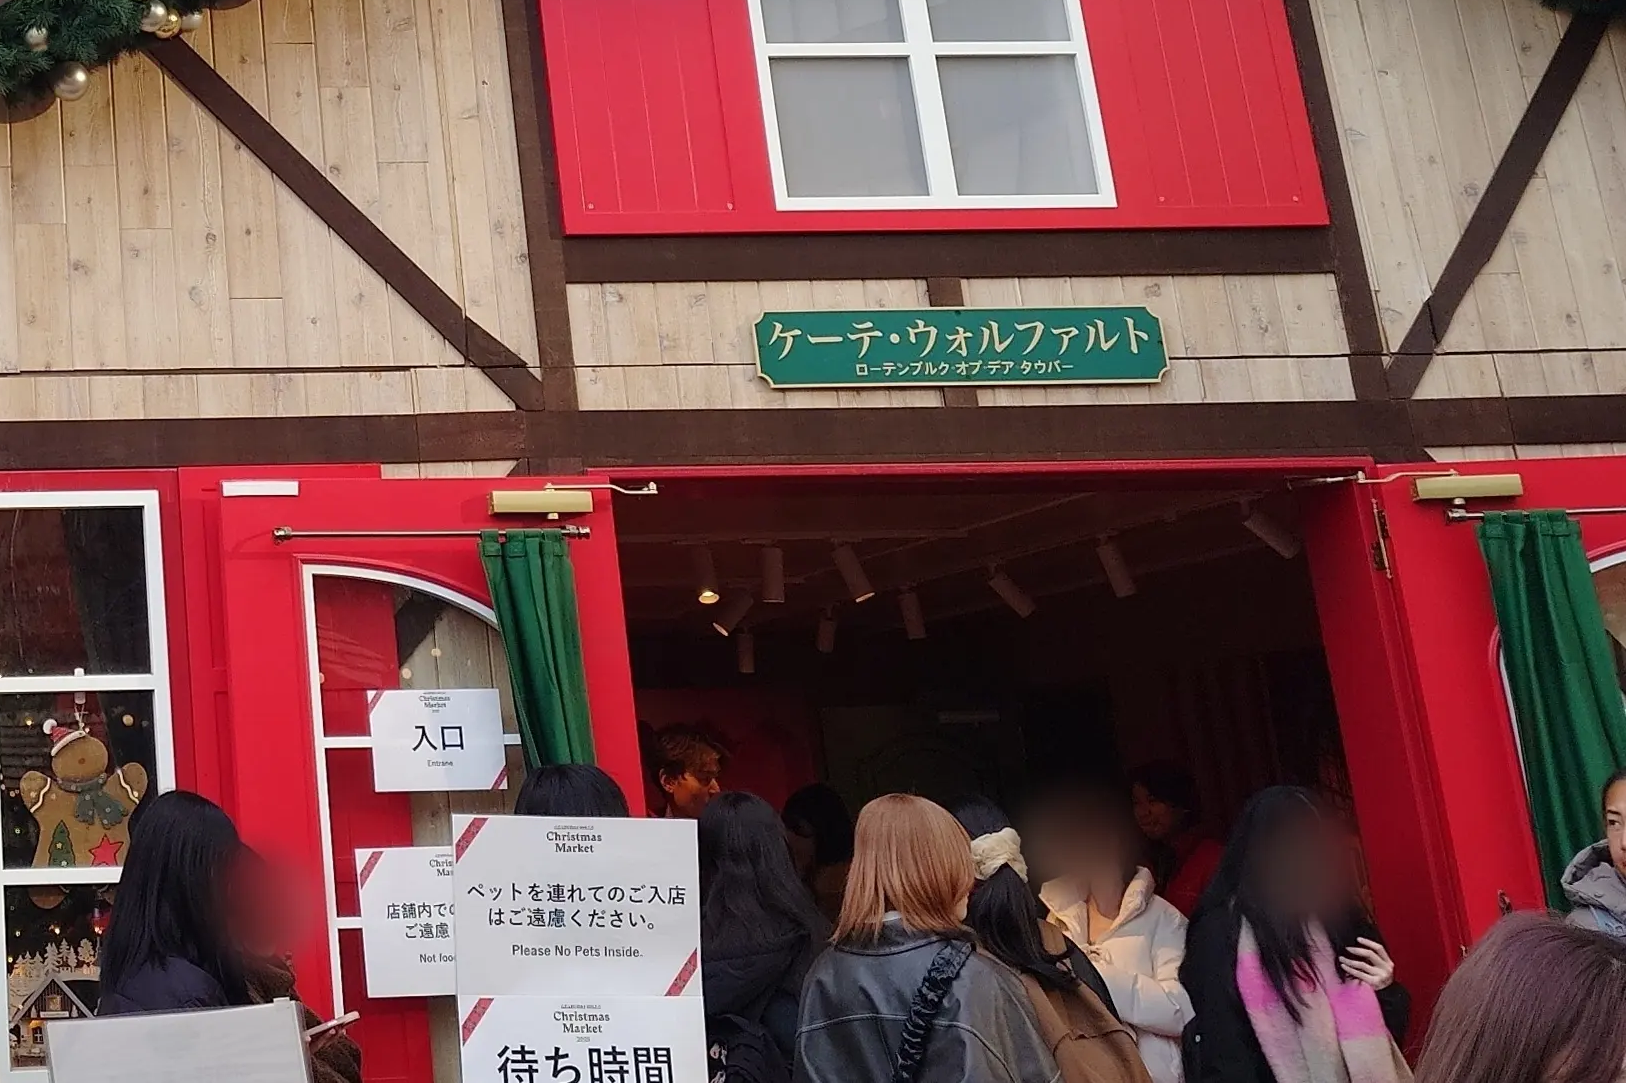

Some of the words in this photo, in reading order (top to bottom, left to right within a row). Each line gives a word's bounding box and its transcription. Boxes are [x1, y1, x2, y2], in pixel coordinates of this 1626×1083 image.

[768, 317, 1149, 359] ケーテ・ウォルファルト
[412, 725, 465, 752] 入口
[546, 831, 602, 842] Christmas
[554, 843, 594, 853] Market
[467, 882, 686, 905] ペットを連れてのご入店
[488, 907, 654, 930] はご遠慮ください。
[405, 922, 450, 939] ご遠慮
[419, 953, 436, 963] Not
[512, 945, 551, 957] Please
[554, 945, 571, 957] No
[574, 946, 601, 957] Pets
[604, 946, 644, 958] Inside.
[553, 1011, 610, 1022] Christmas
[562, 1023, 603, 1034] Market
[497, 1044, 674, 1083] 待ち時間
